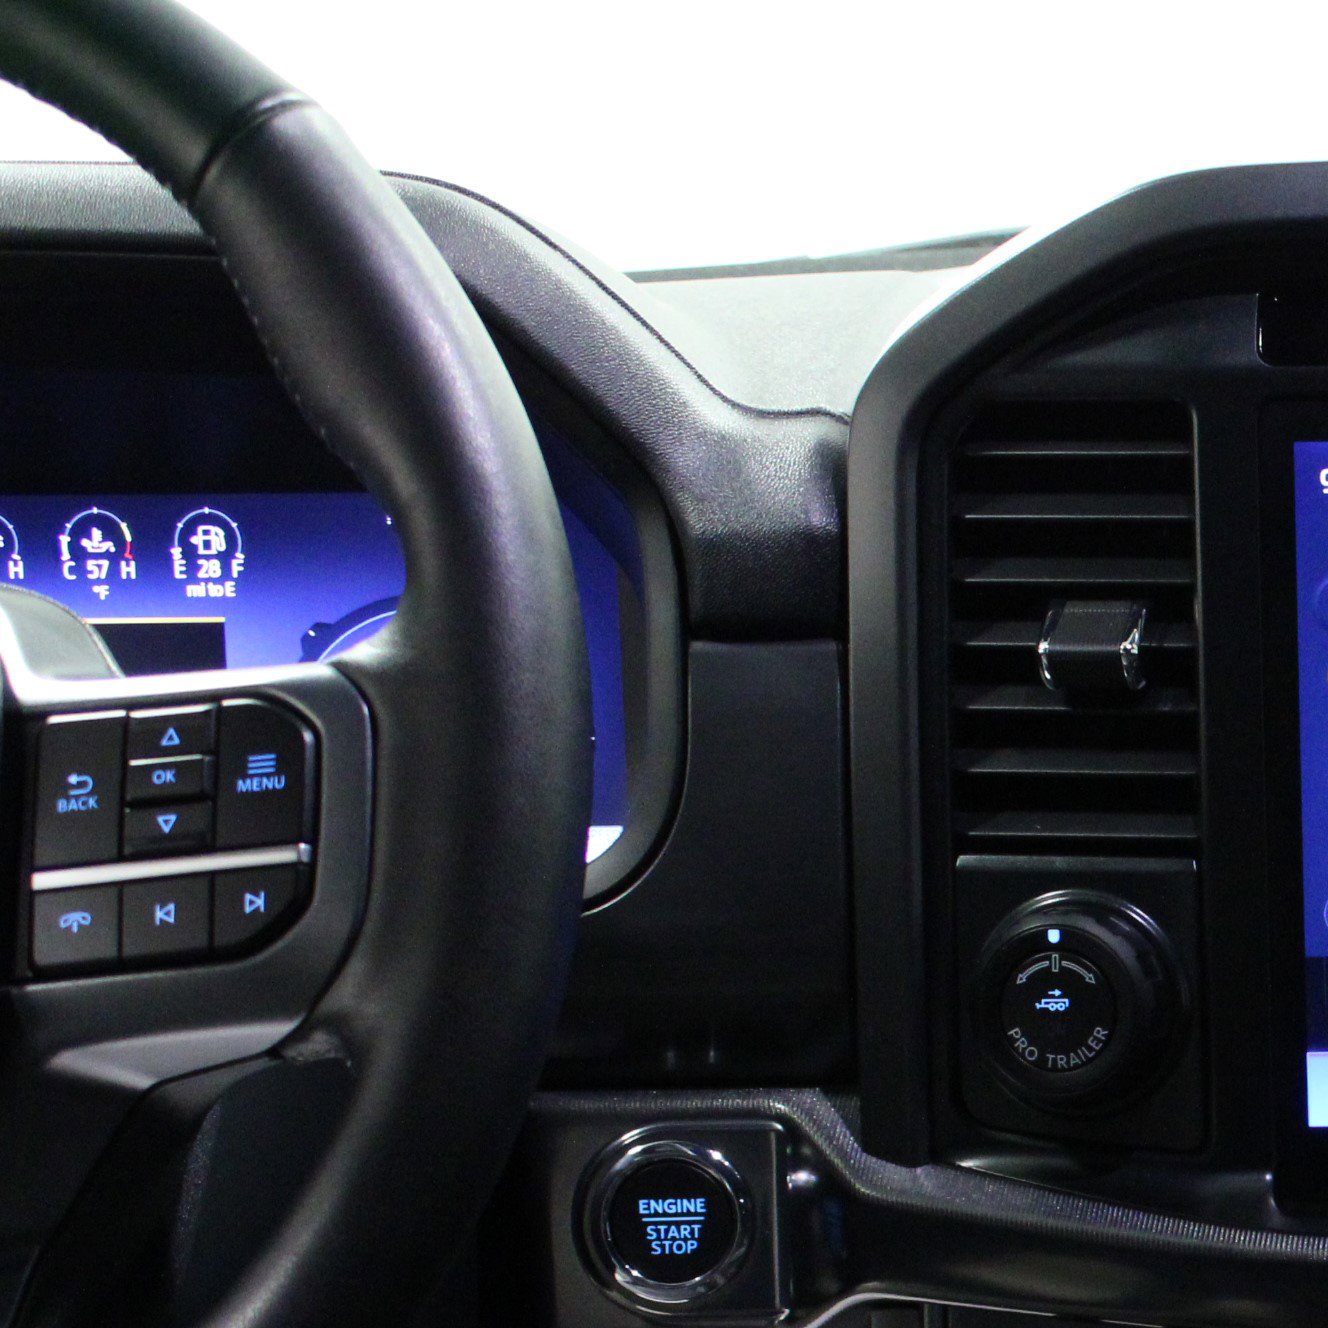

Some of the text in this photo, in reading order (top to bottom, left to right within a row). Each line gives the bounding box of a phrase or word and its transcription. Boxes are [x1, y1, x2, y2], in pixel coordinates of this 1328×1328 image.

[62, 559, 137, 580] C 57 H
[174, 559, 245, 580] E 28 F
[186, 581, 237, 598] mi to E
[152, 769, 176, 785] OK
[236, 774, 286, 793] MENU
[57, 795, 98, 812] BACK
[1007, 1027, 1109, 1069] PRO TRAILER
[638, 1198, 706, 1215] ENGINE
[646, 1224, 702, 1239] START
[650, 1240, 698, 1255] STOP
